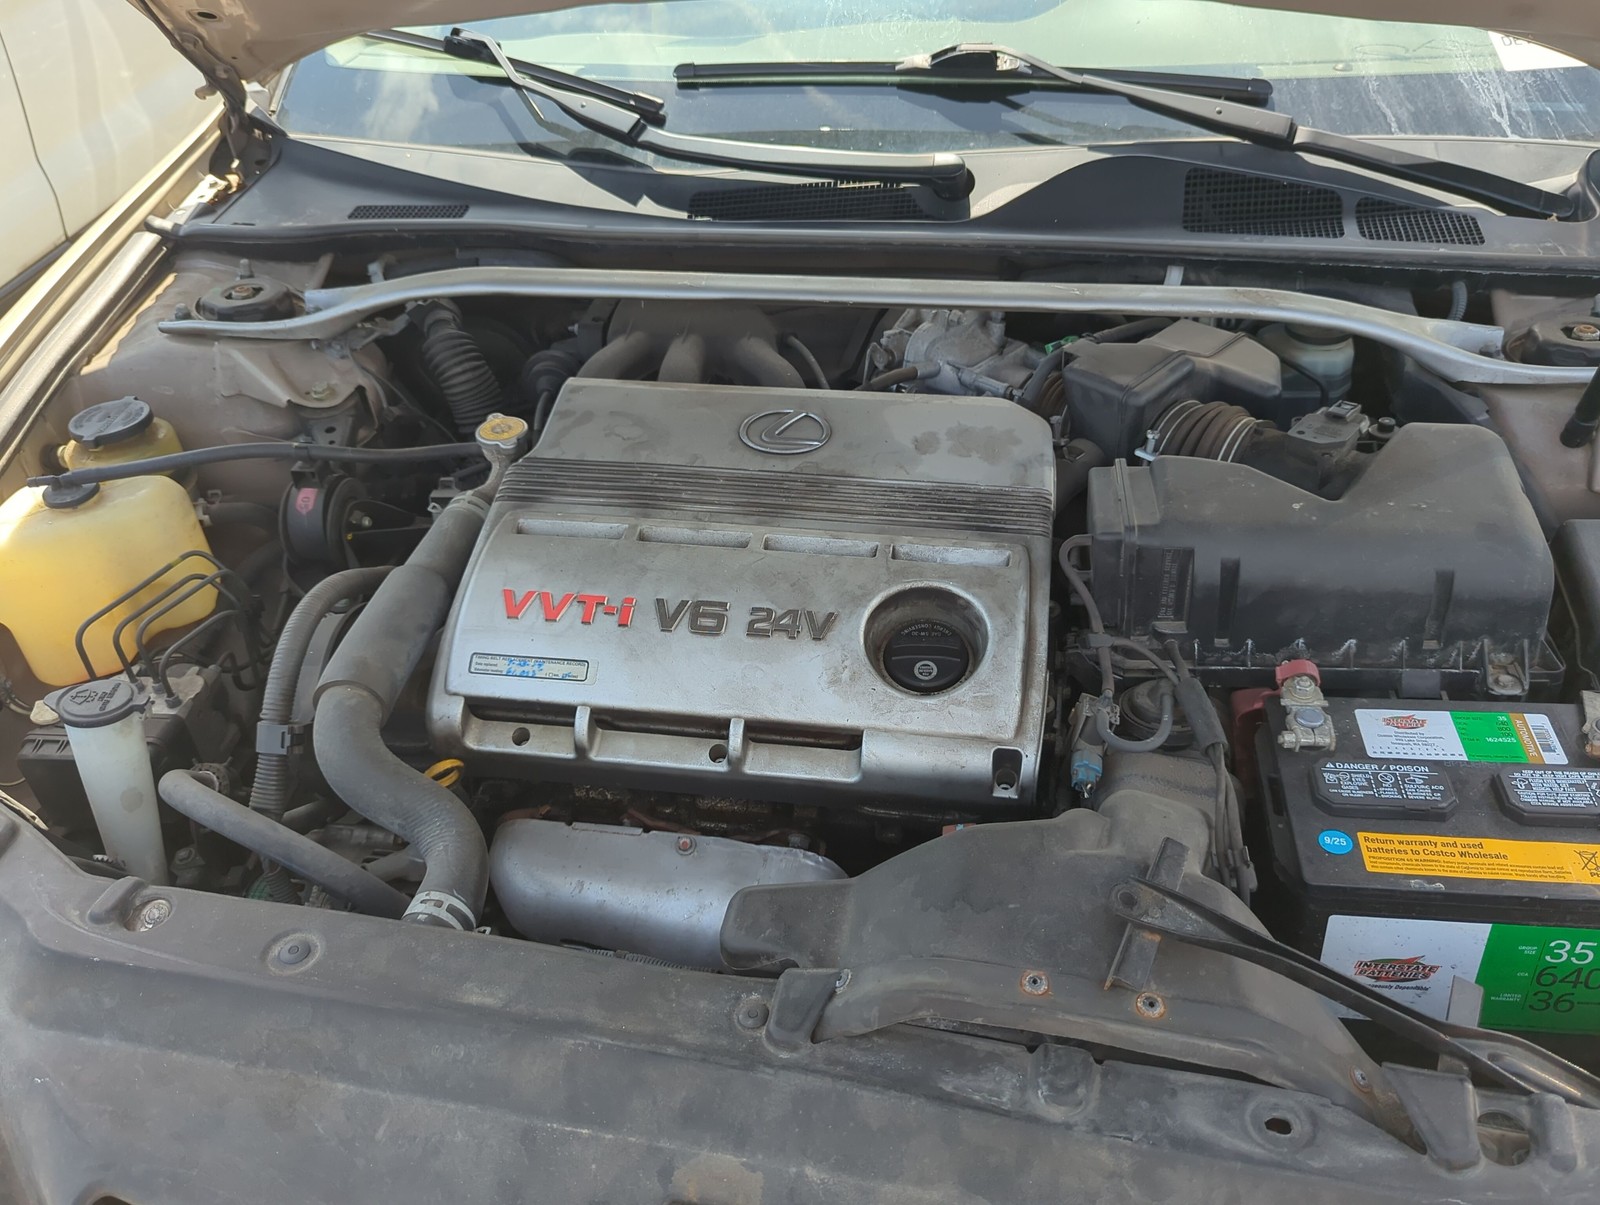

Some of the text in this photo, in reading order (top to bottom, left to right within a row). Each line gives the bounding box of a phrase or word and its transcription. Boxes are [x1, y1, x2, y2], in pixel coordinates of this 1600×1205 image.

[503, 588, 637, 628] VVT-i
[655, 597, 839, 641] V6 24V
[1515, 719, 1538, 757] AUTOMOTIVE
[1335, 762, 1379, 770] DANGER
[1323, 836, 1347, 846] 9/25
[1363, 836, 1395, 845] Return
[1397, 839, 1437, 848] warranty
[1366, 845, 1408, 855] batteries
[1422, 848, 1456, 858] Costco
[1458, 851, 1509, 860] Wholesale
[1545, 939, 1598, 965] 35
[1356, 961, 1439, 974] INTERSTATE
[1357, 969, 1432, 980] BATTERIES
[1528, 990, 1575, 1013] 36
